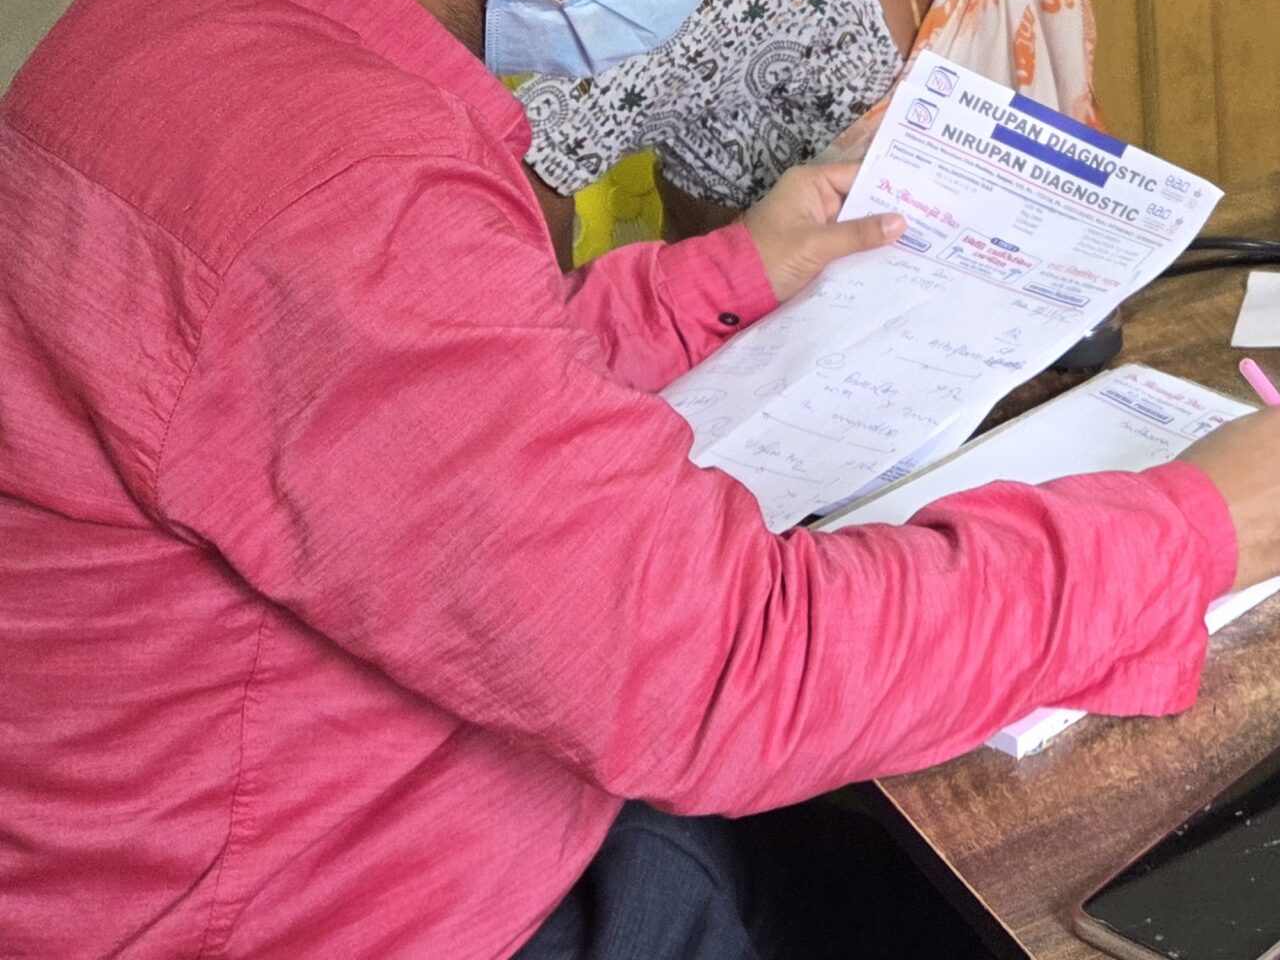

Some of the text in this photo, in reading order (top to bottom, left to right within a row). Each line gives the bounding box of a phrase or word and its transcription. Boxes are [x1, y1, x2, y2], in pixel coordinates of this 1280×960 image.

[941, 123, 1027, 172] NIRUPAN
[1030, 166, 1140, 222] DIAGNOSTIC
[958, 90, 1158, 193] NIRUPAN DIAGNOSTIC
